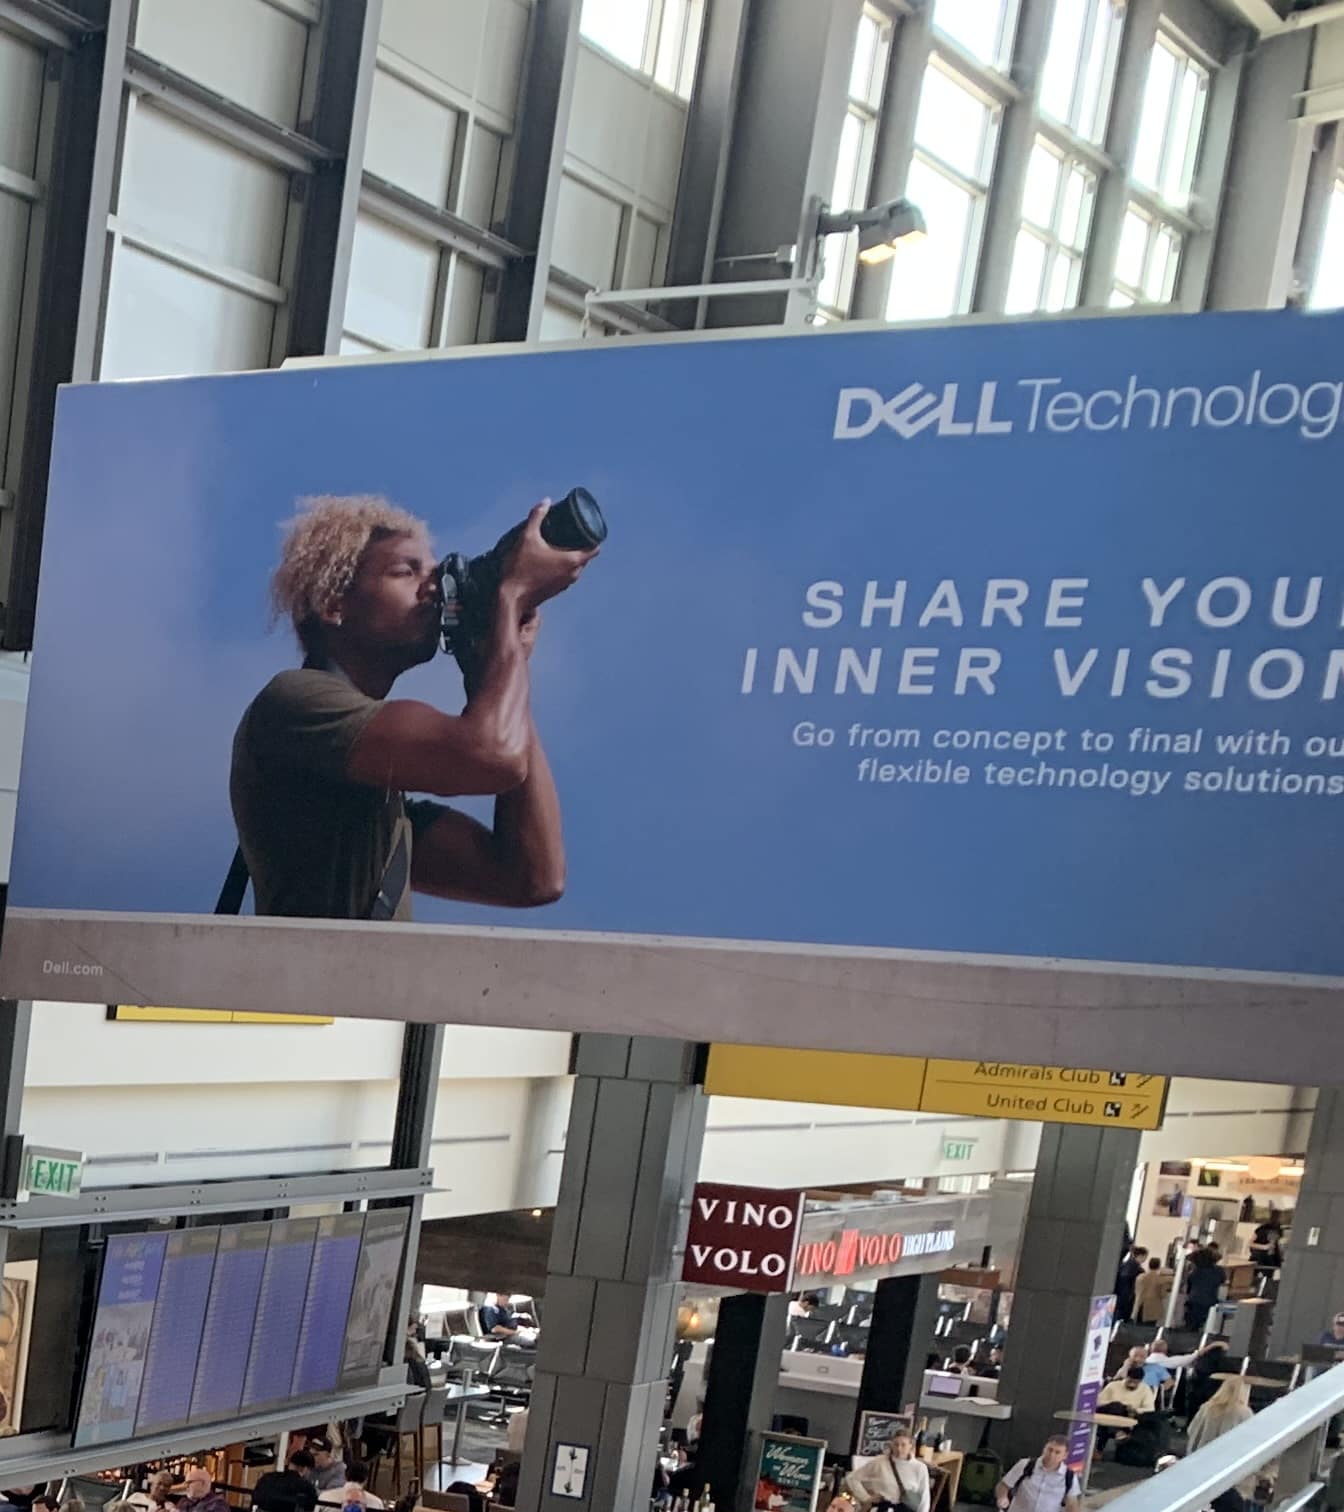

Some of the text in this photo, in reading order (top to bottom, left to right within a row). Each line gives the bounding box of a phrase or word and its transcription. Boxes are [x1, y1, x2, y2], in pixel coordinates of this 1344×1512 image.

[832, 369, 1343, 440] DELL Technolog
[802, 575, 1344, 629] SHARE YOU
[741, 647, 1002, 696] INNER
[792, 721, 835, 747] Go
[848, 723, 921, 748] from
[933, 727, 1068, 757] concept
[1080, 728, 1114, 752] to
[1129, 727, 1203, 753] final
[1216, 728, 1291, 756] with
[857, 758, 971, 784] flexible
[984, 761, 1172, 796] technology
[42, 959, 104, 977] Dell.com
[974, 1061, 1101, 1085] Admirals Club
[986, 1093, 1095, 1115] United Club
[945, 1142, 976, 1161] EXIT
[33, 1159, 78, 1193] EXIT
[697, 1198, 793, 1229] VINO
[691, 1244, 786, 1277] VOLO
[858, 1231, 903, 1266] VOLO
